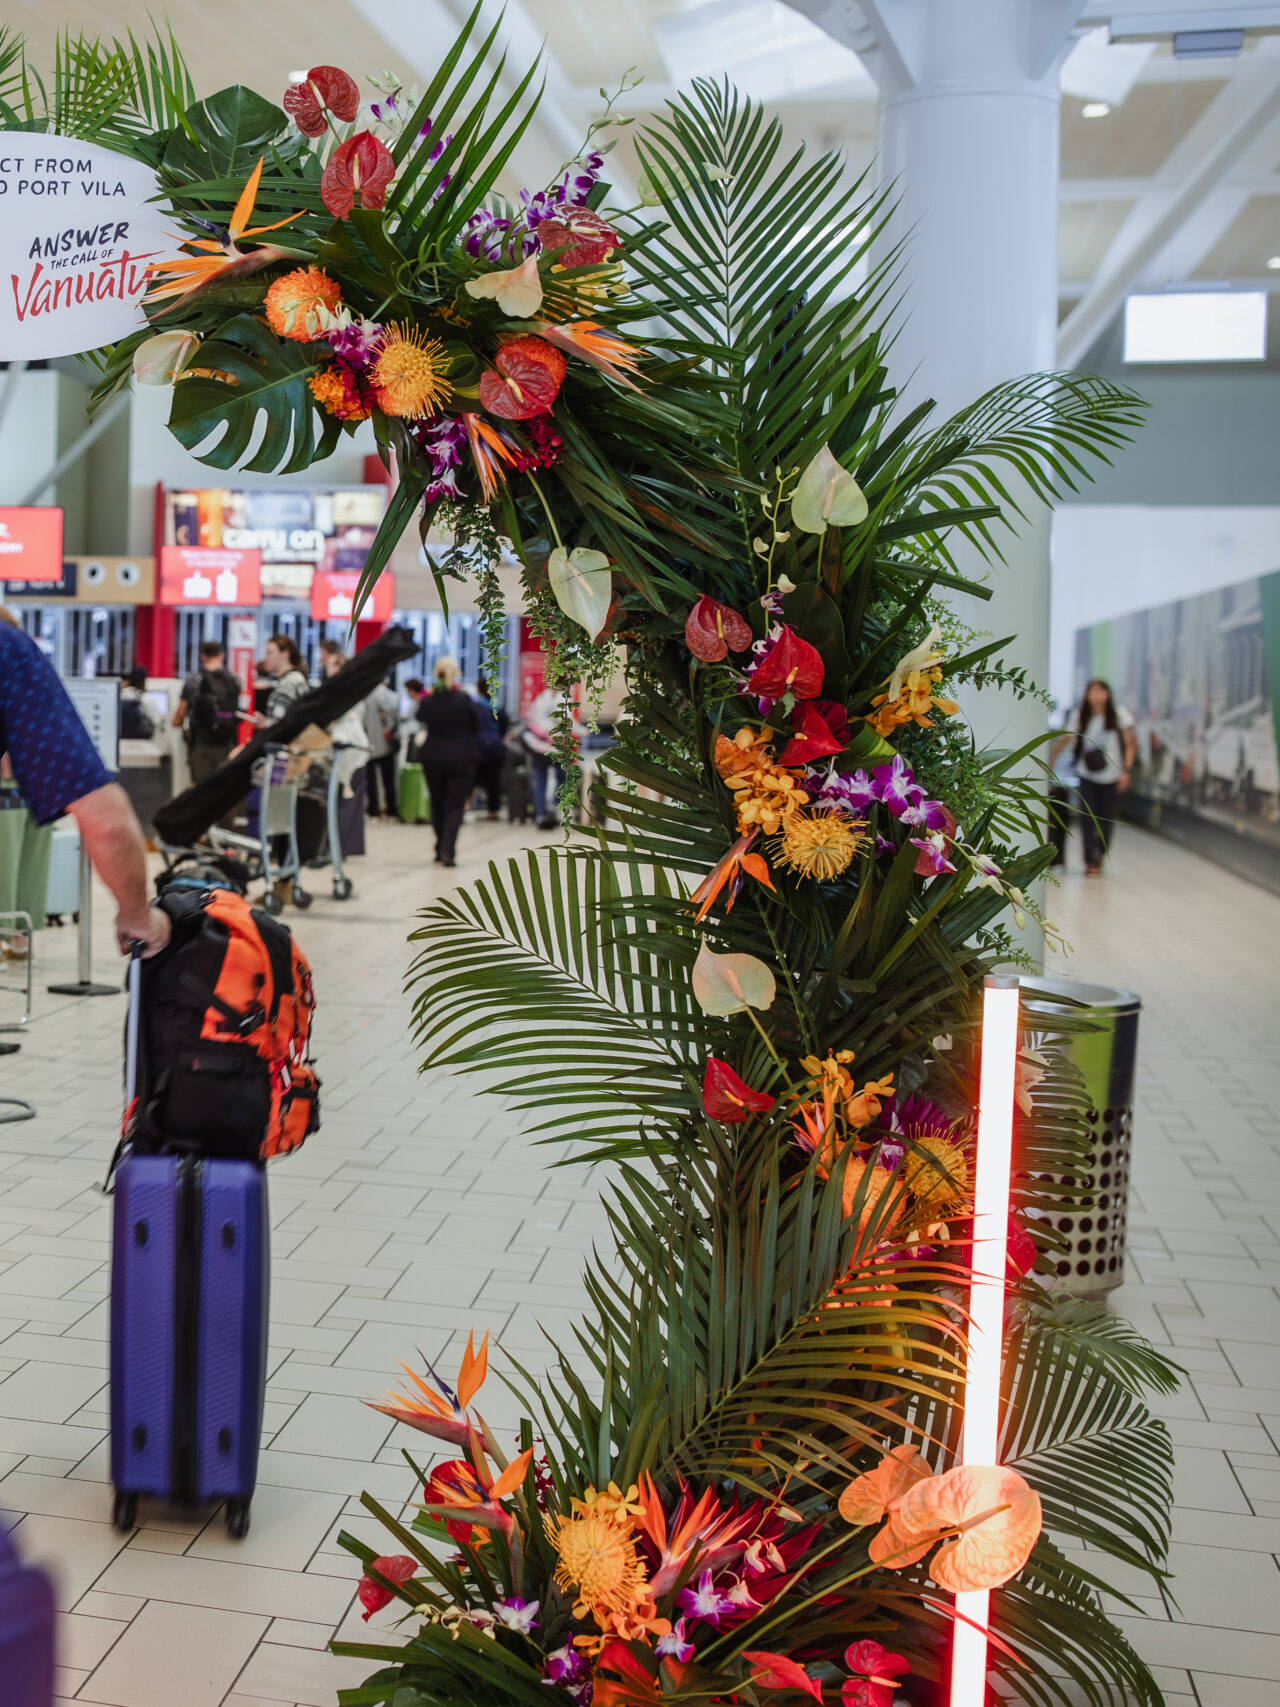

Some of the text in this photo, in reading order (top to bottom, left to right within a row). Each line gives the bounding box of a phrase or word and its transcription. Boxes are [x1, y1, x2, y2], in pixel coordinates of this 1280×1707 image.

[34, 158, 93, 174] FROM
[17, 180, 71, 196] PORT
[81, 181, 127, 197] VILA
[28, 221, 130, 260] ANSWER
[50, 248, 115, 270] THE CALL OF
[10, 249, 166, 322] Vanuatu
[289, 528, 326, 550] on
